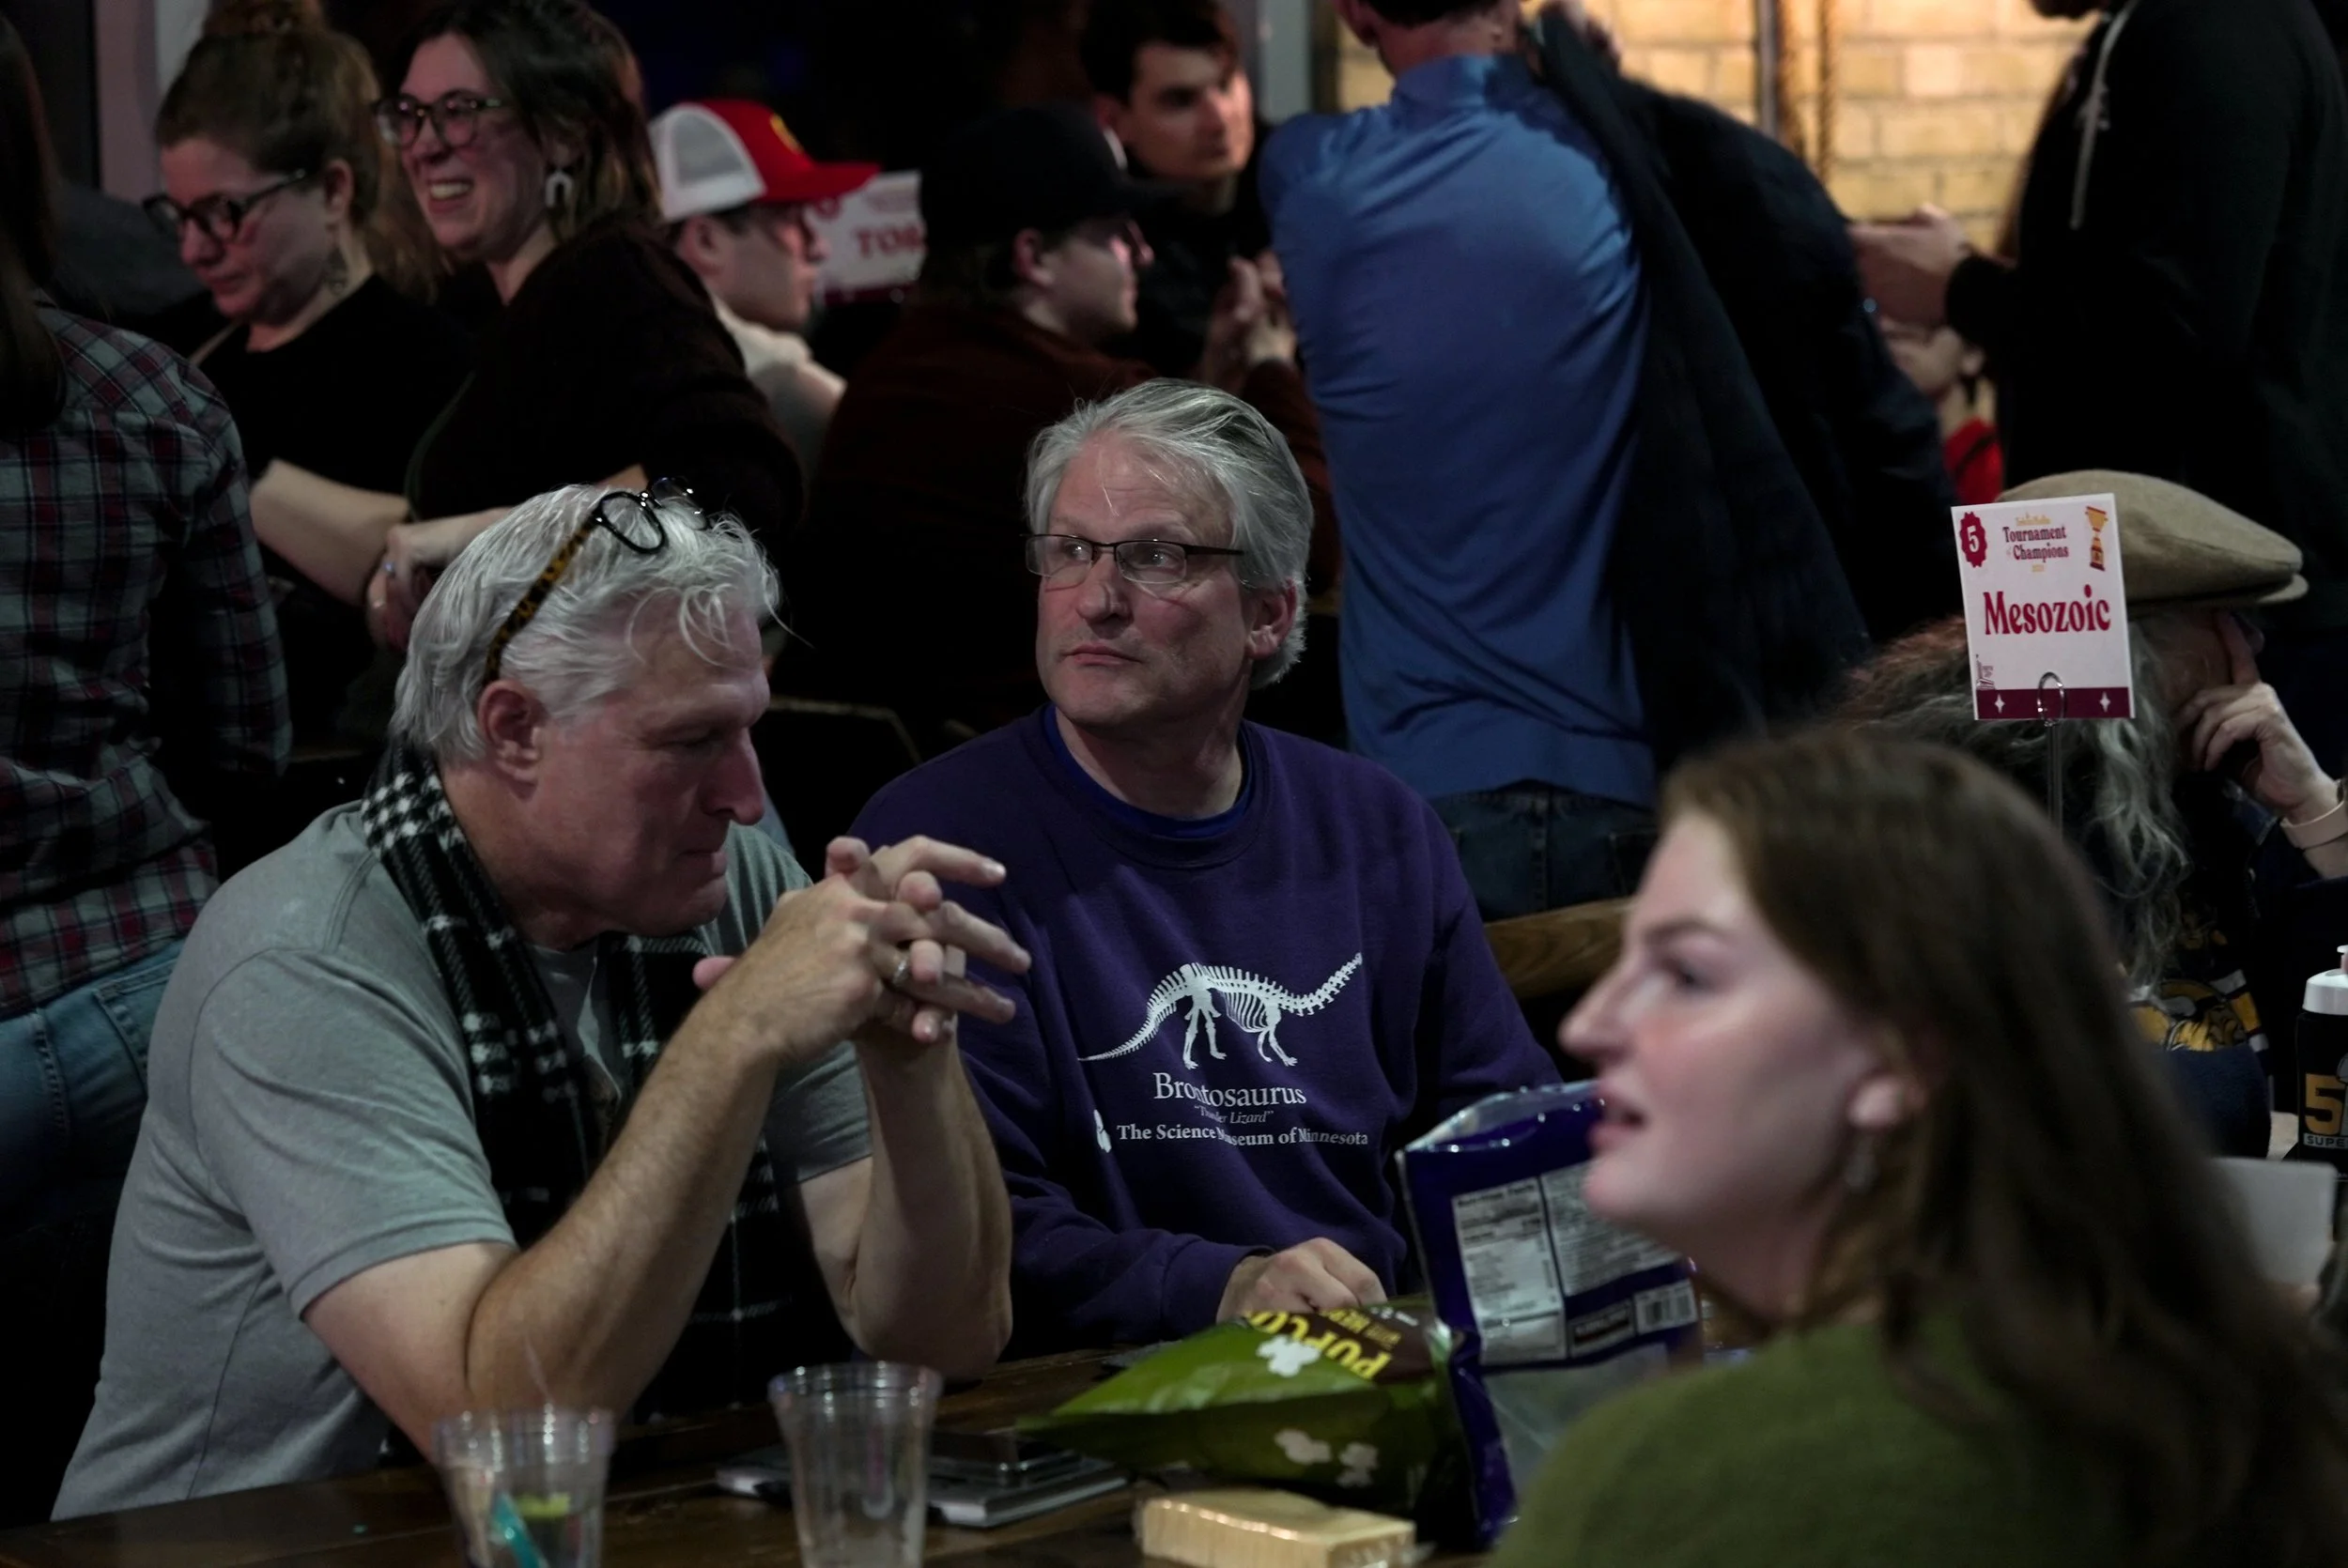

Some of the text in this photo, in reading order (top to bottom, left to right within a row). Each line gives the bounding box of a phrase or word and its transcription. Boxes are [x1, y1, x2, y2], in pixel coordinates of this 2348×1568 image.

[1966, 525, 1980, 554] 5
[2002, 525, 2067, 543] Tournament
[2013, 542, 2070, 563] Champions
[1983, 584, 2111, 636] Mesozoic
[1152, 1072, 1307, 1107] Brontosaurus
[1116, 1123, 1152, 1140] The
[1156, 1123, 1218, 1140] Science
[1277, 1127, 1298, 1145] of
